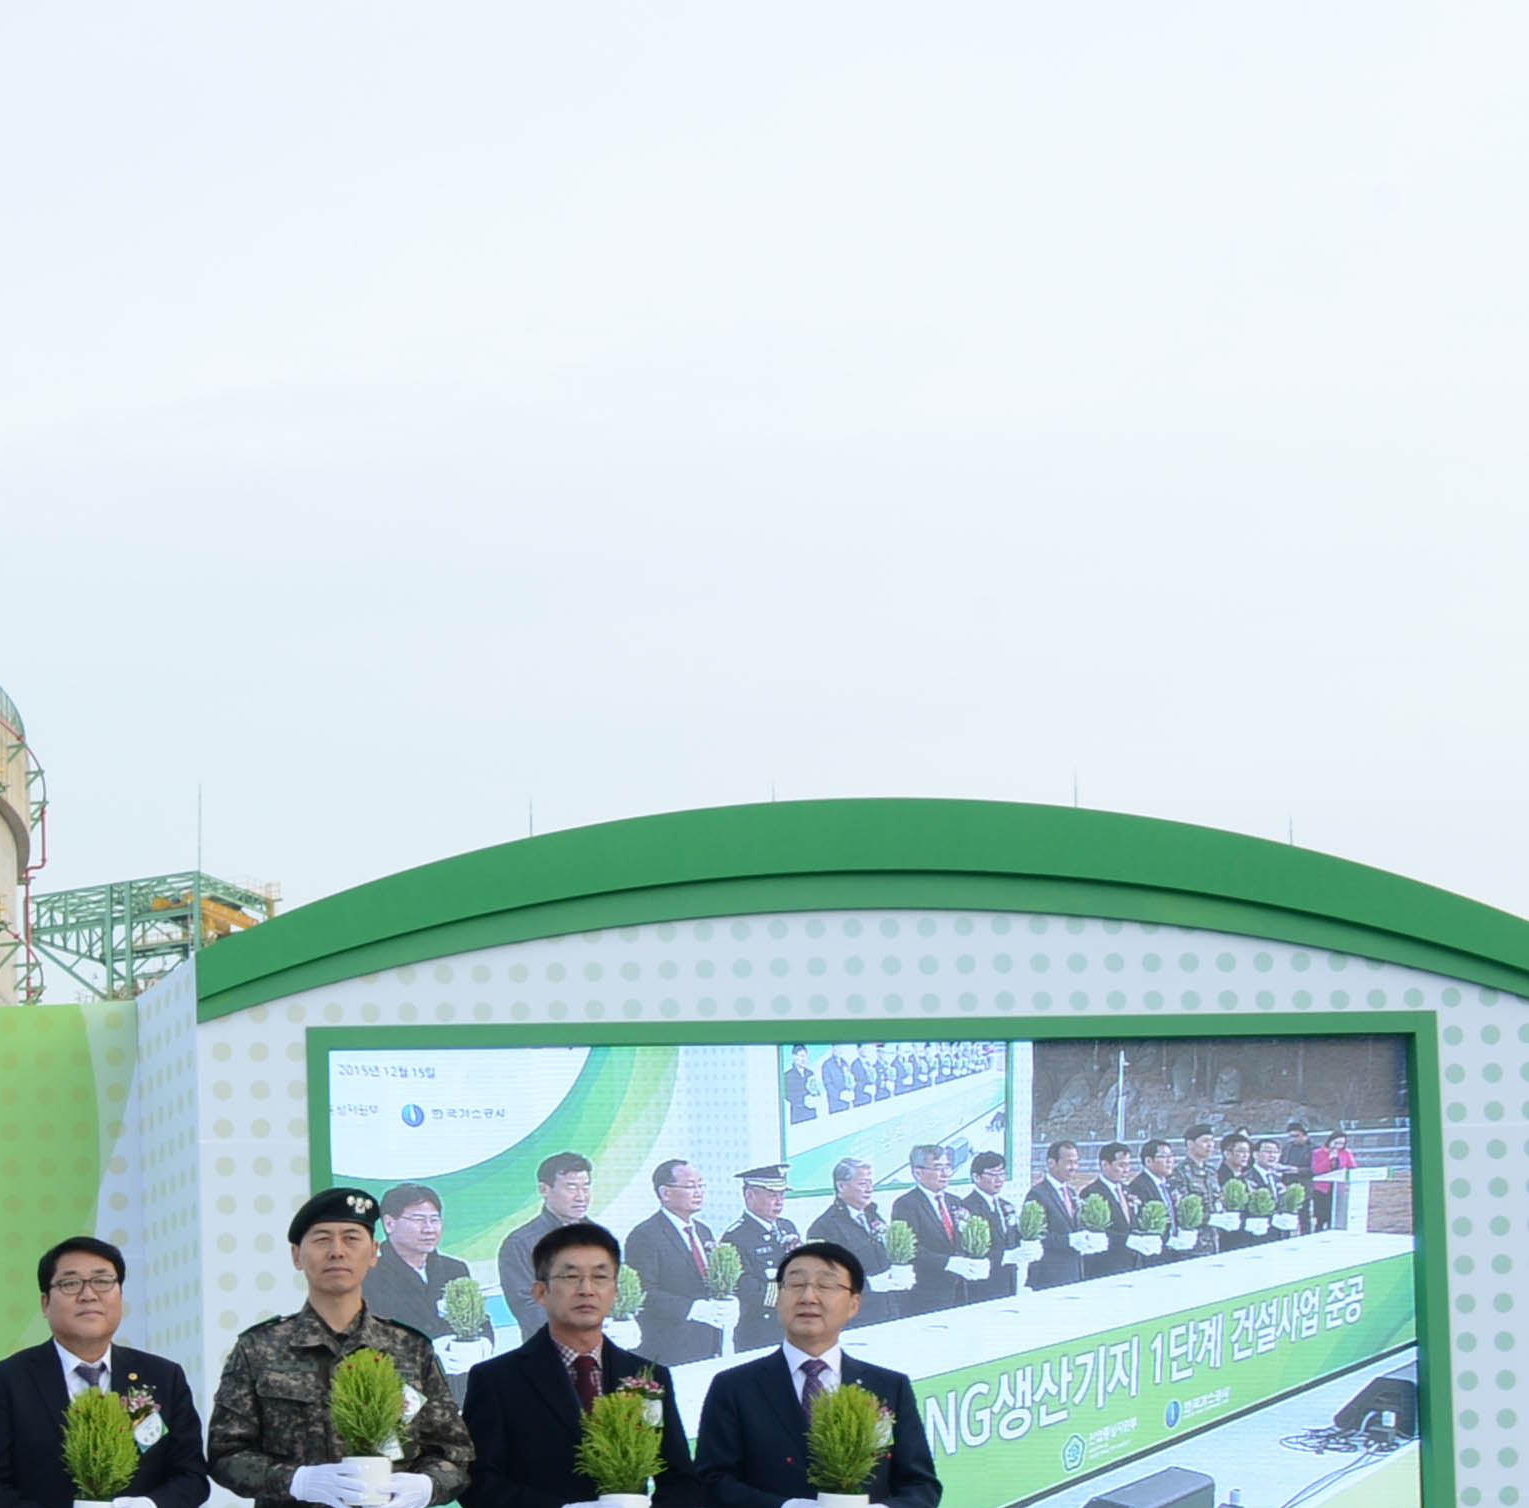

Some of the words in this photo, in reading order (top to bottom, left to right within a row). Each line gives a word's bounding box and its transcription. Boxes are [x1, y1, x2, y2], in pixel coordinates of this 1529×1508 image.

[925, 1334, 1139, 1460] NG생산기지
[1149, 1312, 1224, 1385] 1단계
[1231, 1285, 1322, 1362] 건설사업
[1325, 1273, 1365, 1331] 준공
